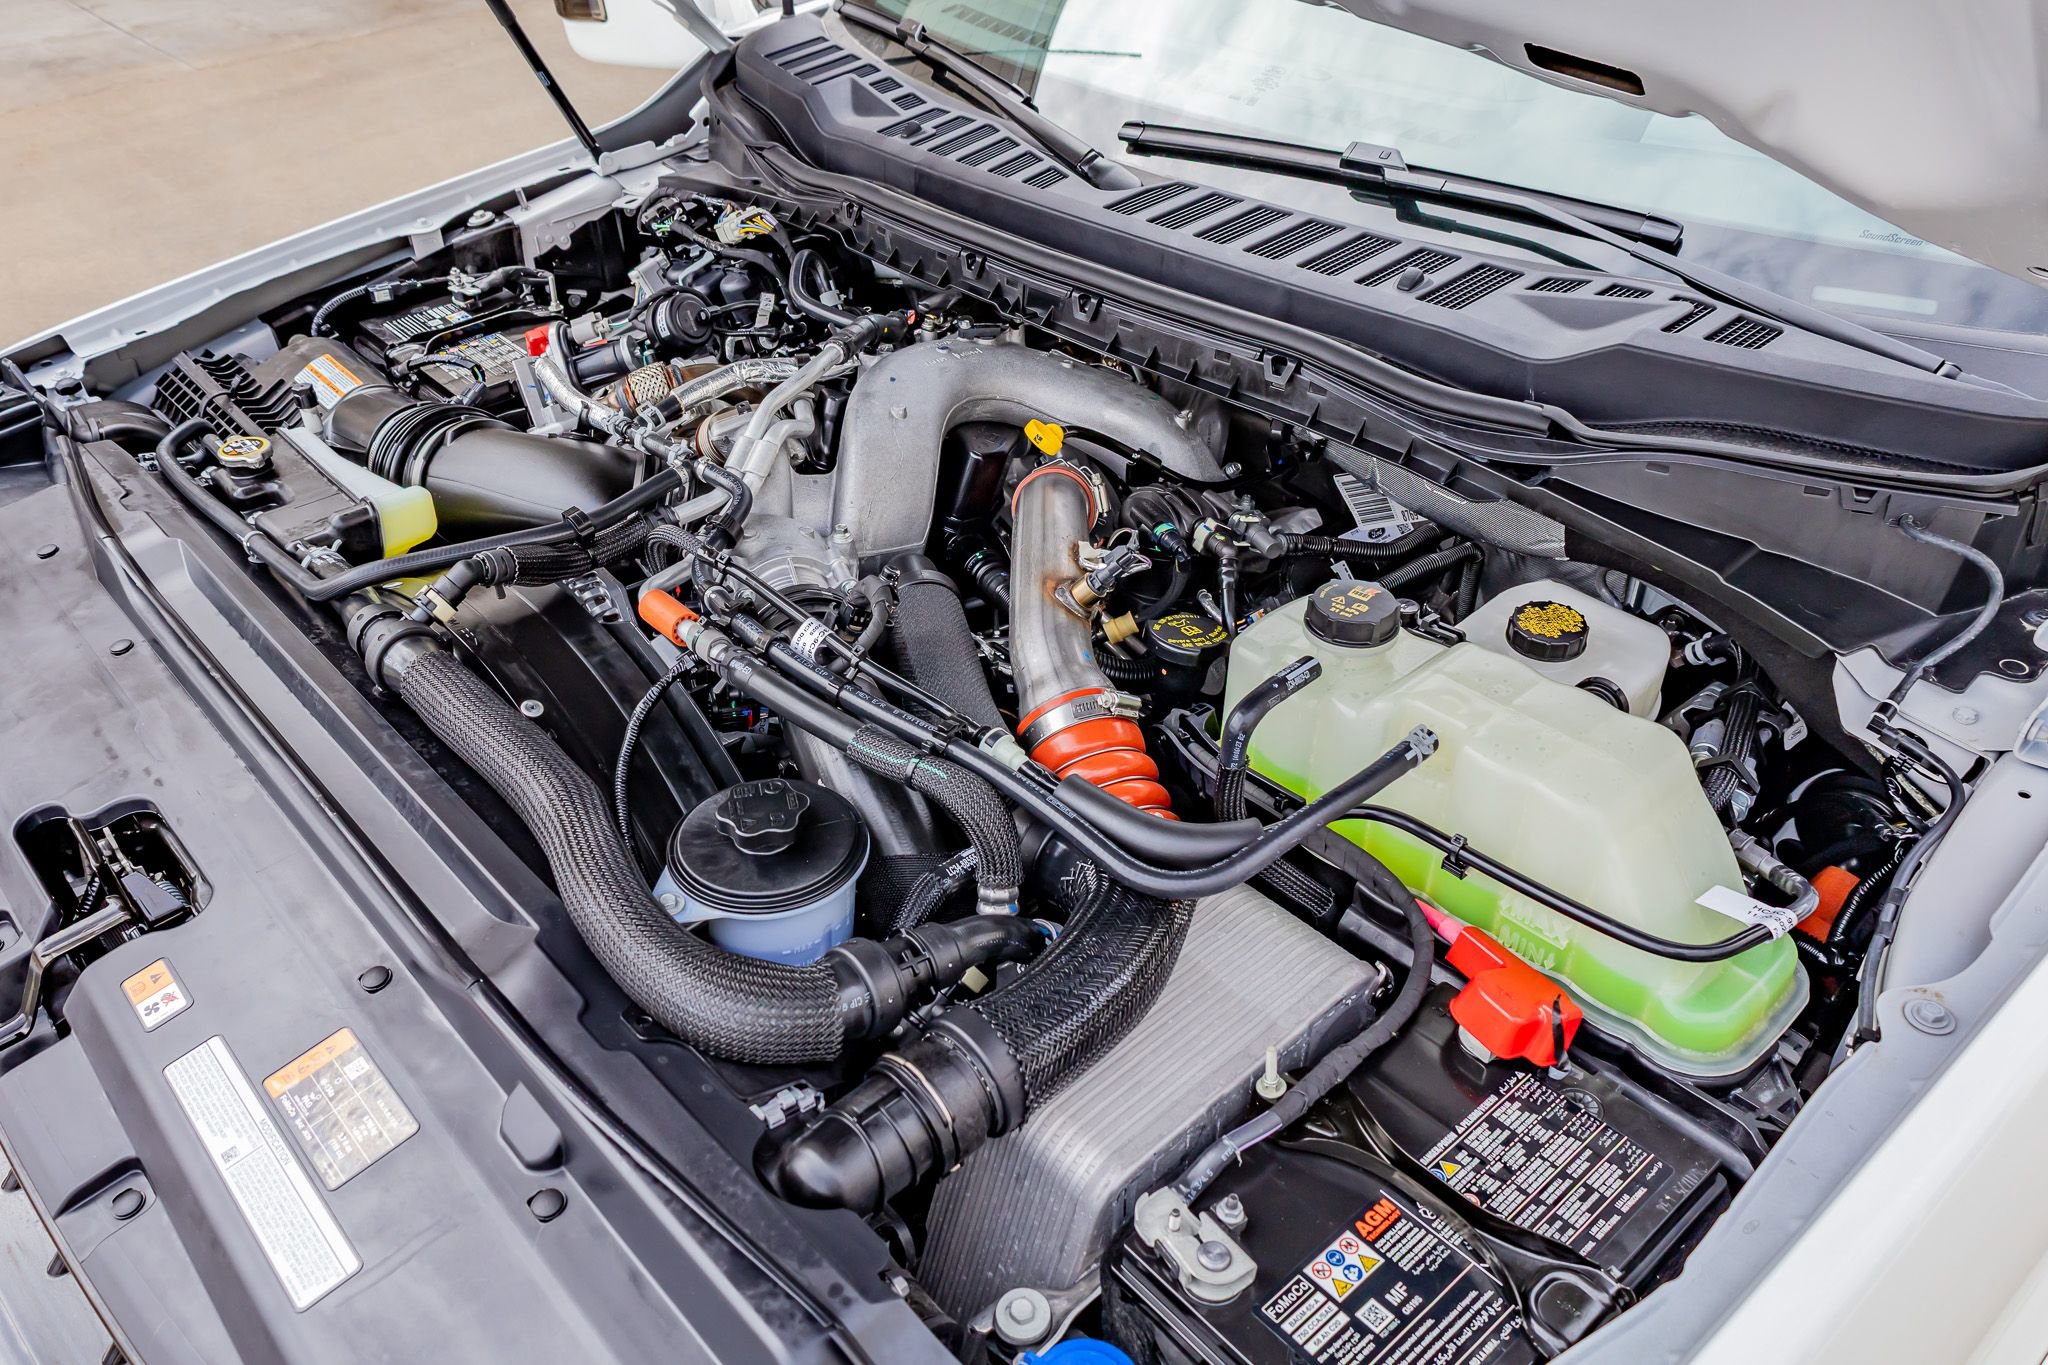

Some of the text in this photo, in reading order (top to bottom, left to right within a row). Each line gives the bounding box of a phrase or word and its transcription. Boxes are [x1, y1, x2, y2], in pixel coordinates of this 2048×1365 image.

[1859, 229, 1924, 247] SoundScreen
[854, 689, 870, 701] MEX
[1511, 896, 1569, 940] MAX
[1498, 923, 1545, 967] MIN
[279, 1094, 297, 1118] FoMoCo
[259, 1117, 291, 1166] MODIFICATION
[1355, 1198, 1397, 1238] AGM
[1365, 1209, 1402, 1242] TECHNOLOGY
[1268, 1281, 1310, 1320] FoMoCo
[1385, 1281, 1410, 1306] MF
[1289, 1298, 1320, 1327] BAGM-65-A
[1297, 1305, 1335, 1341] 750 CCA/SAE
[1322, 1329, 1331, 1339] Ah
[1329, 1319, 1342, 1332] C20
